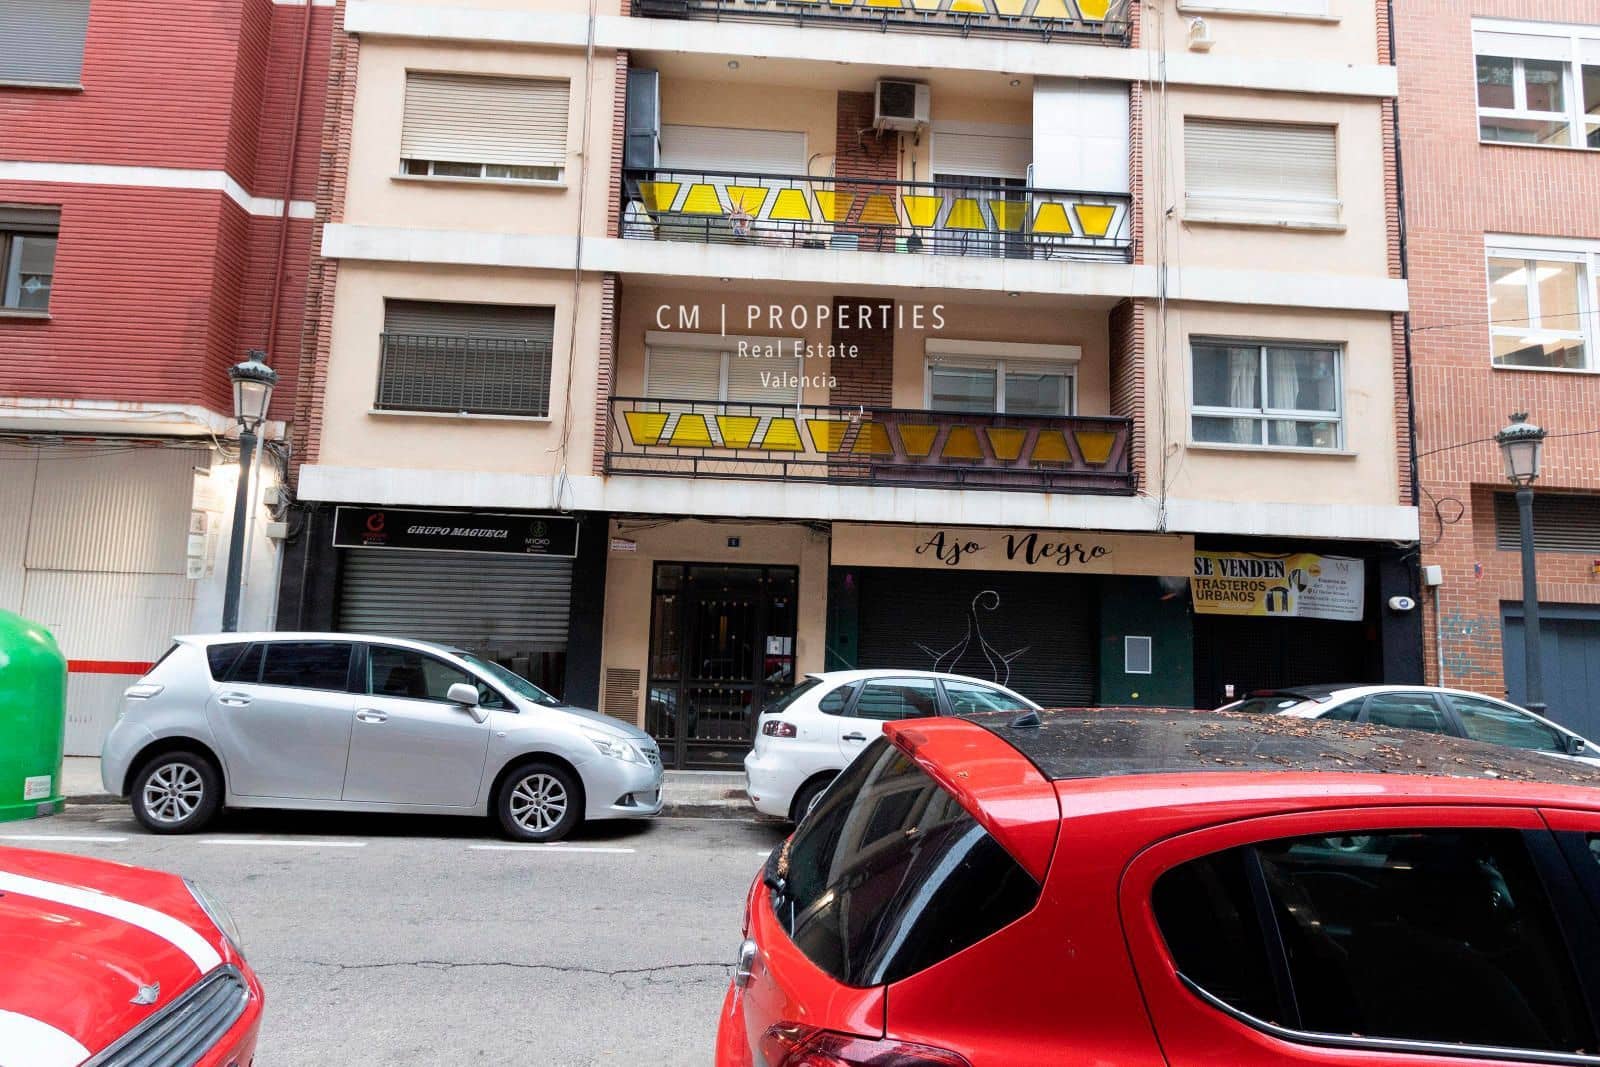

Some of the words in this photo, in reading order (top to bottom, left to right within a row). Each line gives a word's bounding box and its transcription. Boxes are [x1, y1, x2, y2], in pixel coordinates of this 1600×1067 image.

[407, 525, 450, 537] GRUPO
[451, 527, 509, 539] MAGUECA
[915, 531, 985, 566] Ajo
[1001, 533, 1112, 567] Negro
[1194, 557, 1213, 576] SE
[1218, 558, 1285, 578] VENDEN
[1195, 578, 1266, 592] TRASTEROS
[1196, 591, 1256, 602] URBANOS
